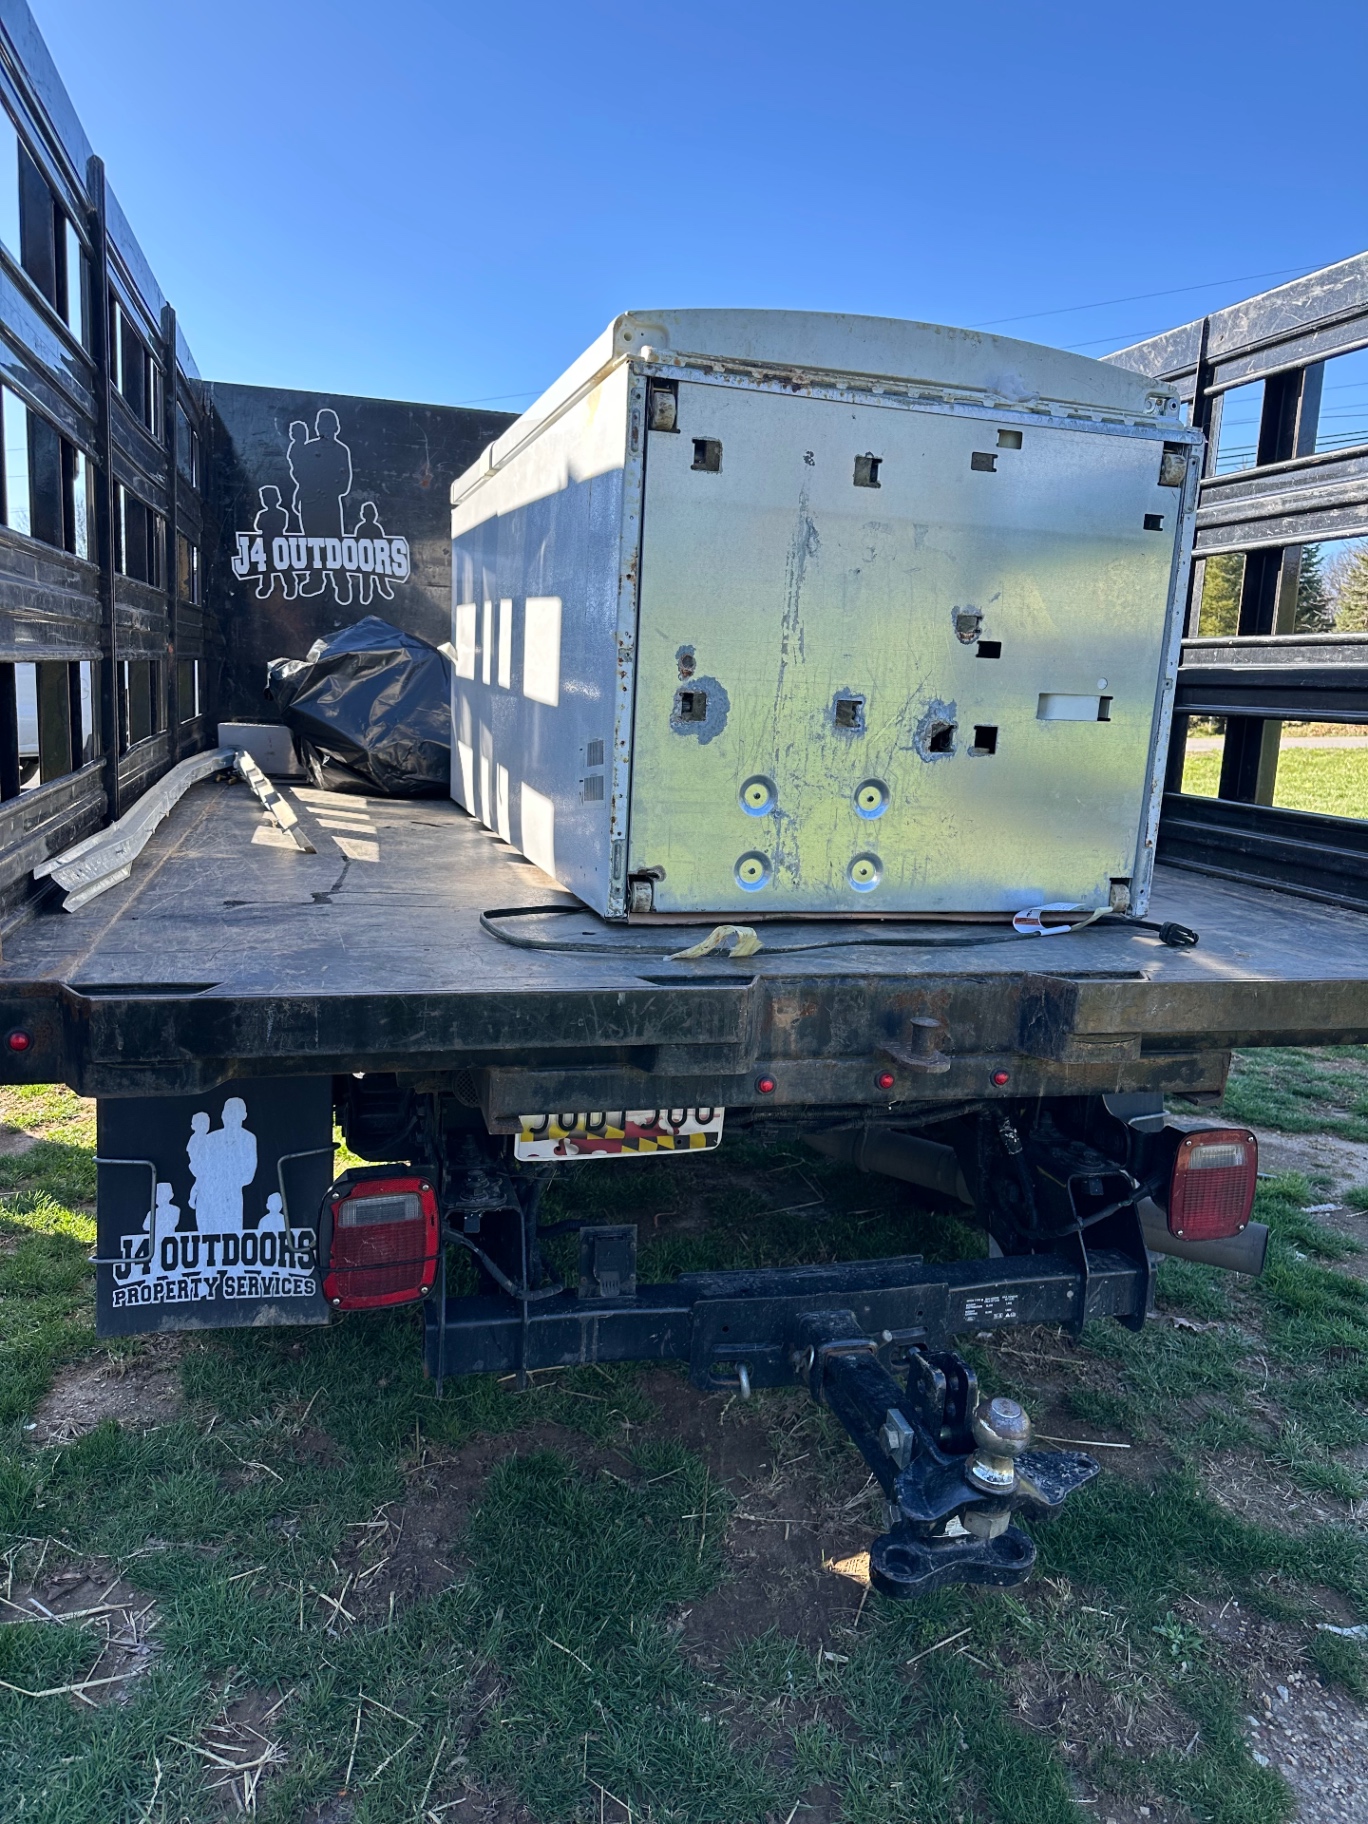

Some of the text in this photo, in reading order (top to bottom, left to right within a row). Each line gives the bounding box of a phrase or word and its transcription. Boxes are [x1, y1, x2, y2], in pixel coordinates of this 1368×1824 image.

[235, 537, 408, 577] J4 OUTDOORS
[115, 1231, 316, 1280] J4 OUTDOORS
[114, 1275, 316, 1306] PROPERTY SERVICES
